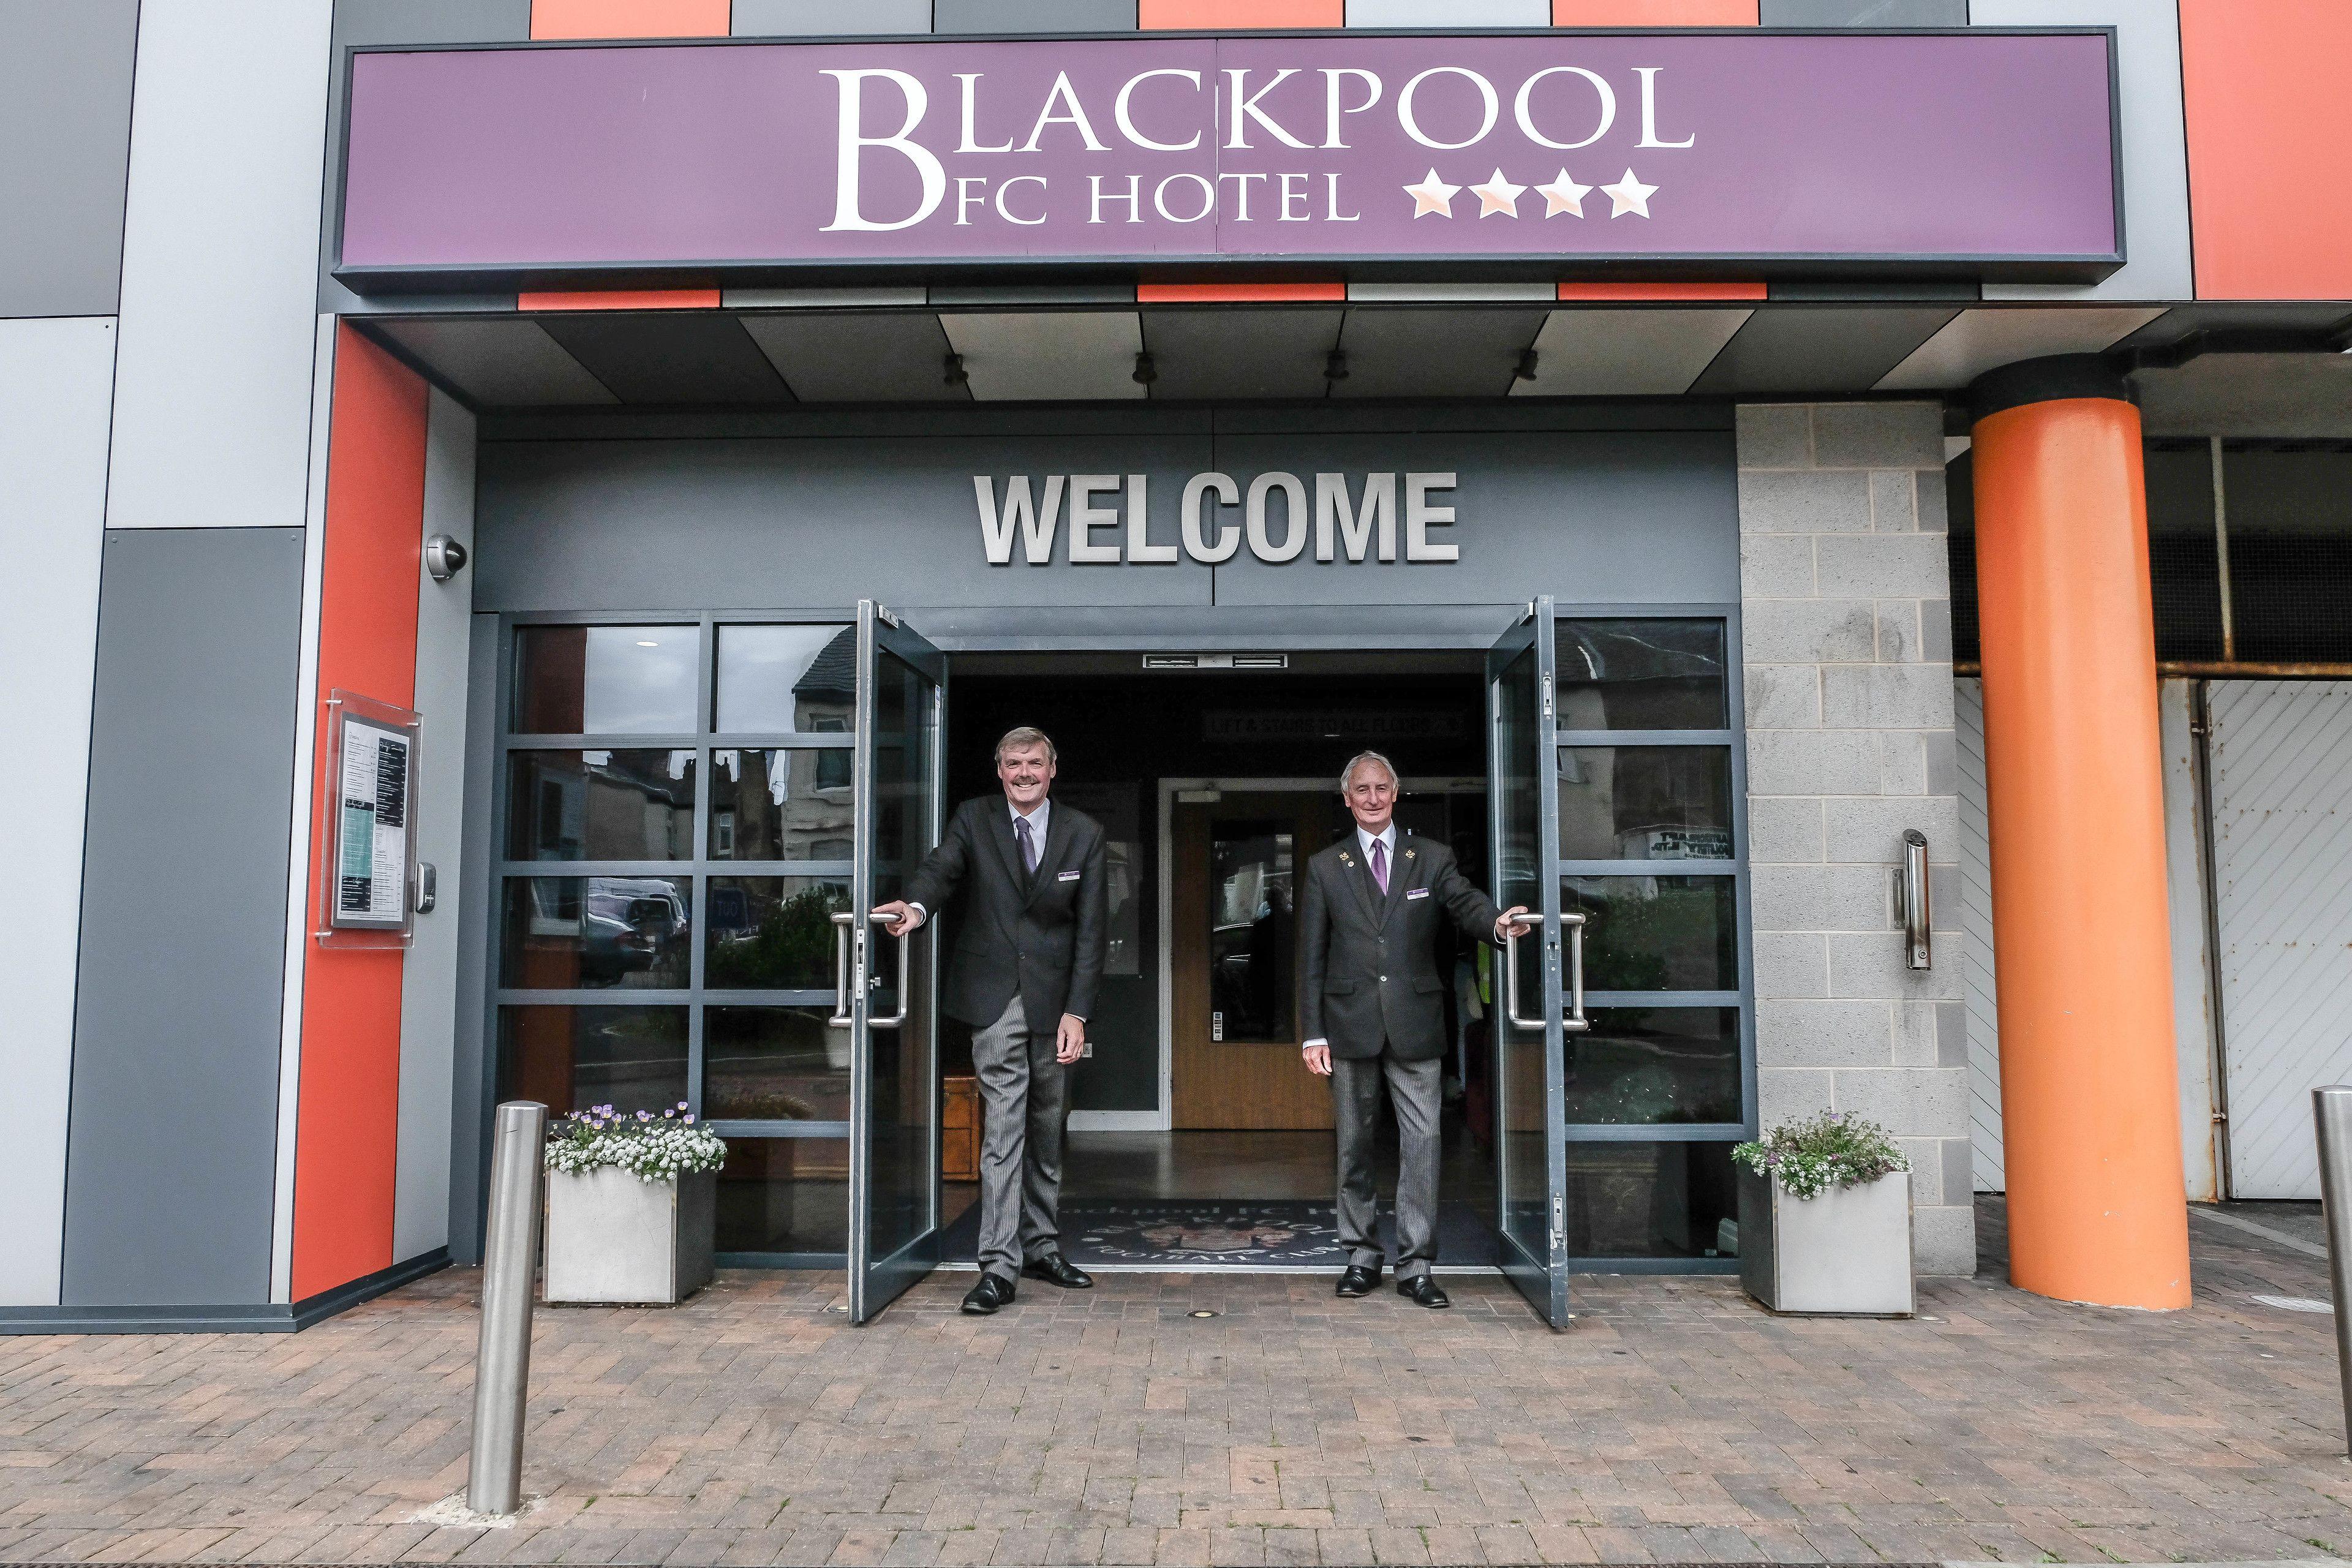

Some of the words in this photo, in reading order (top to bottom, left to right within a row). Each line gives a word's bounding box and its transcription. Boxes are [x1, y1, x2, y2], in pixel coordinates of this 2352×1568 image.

[818, 66, 1695, 232] BLACKPOOL
[952, 175, 1047, 225] FC
[1085, 173, 1360, 224] HOTEL
[973, 472, 1459, 563] WELCOME
